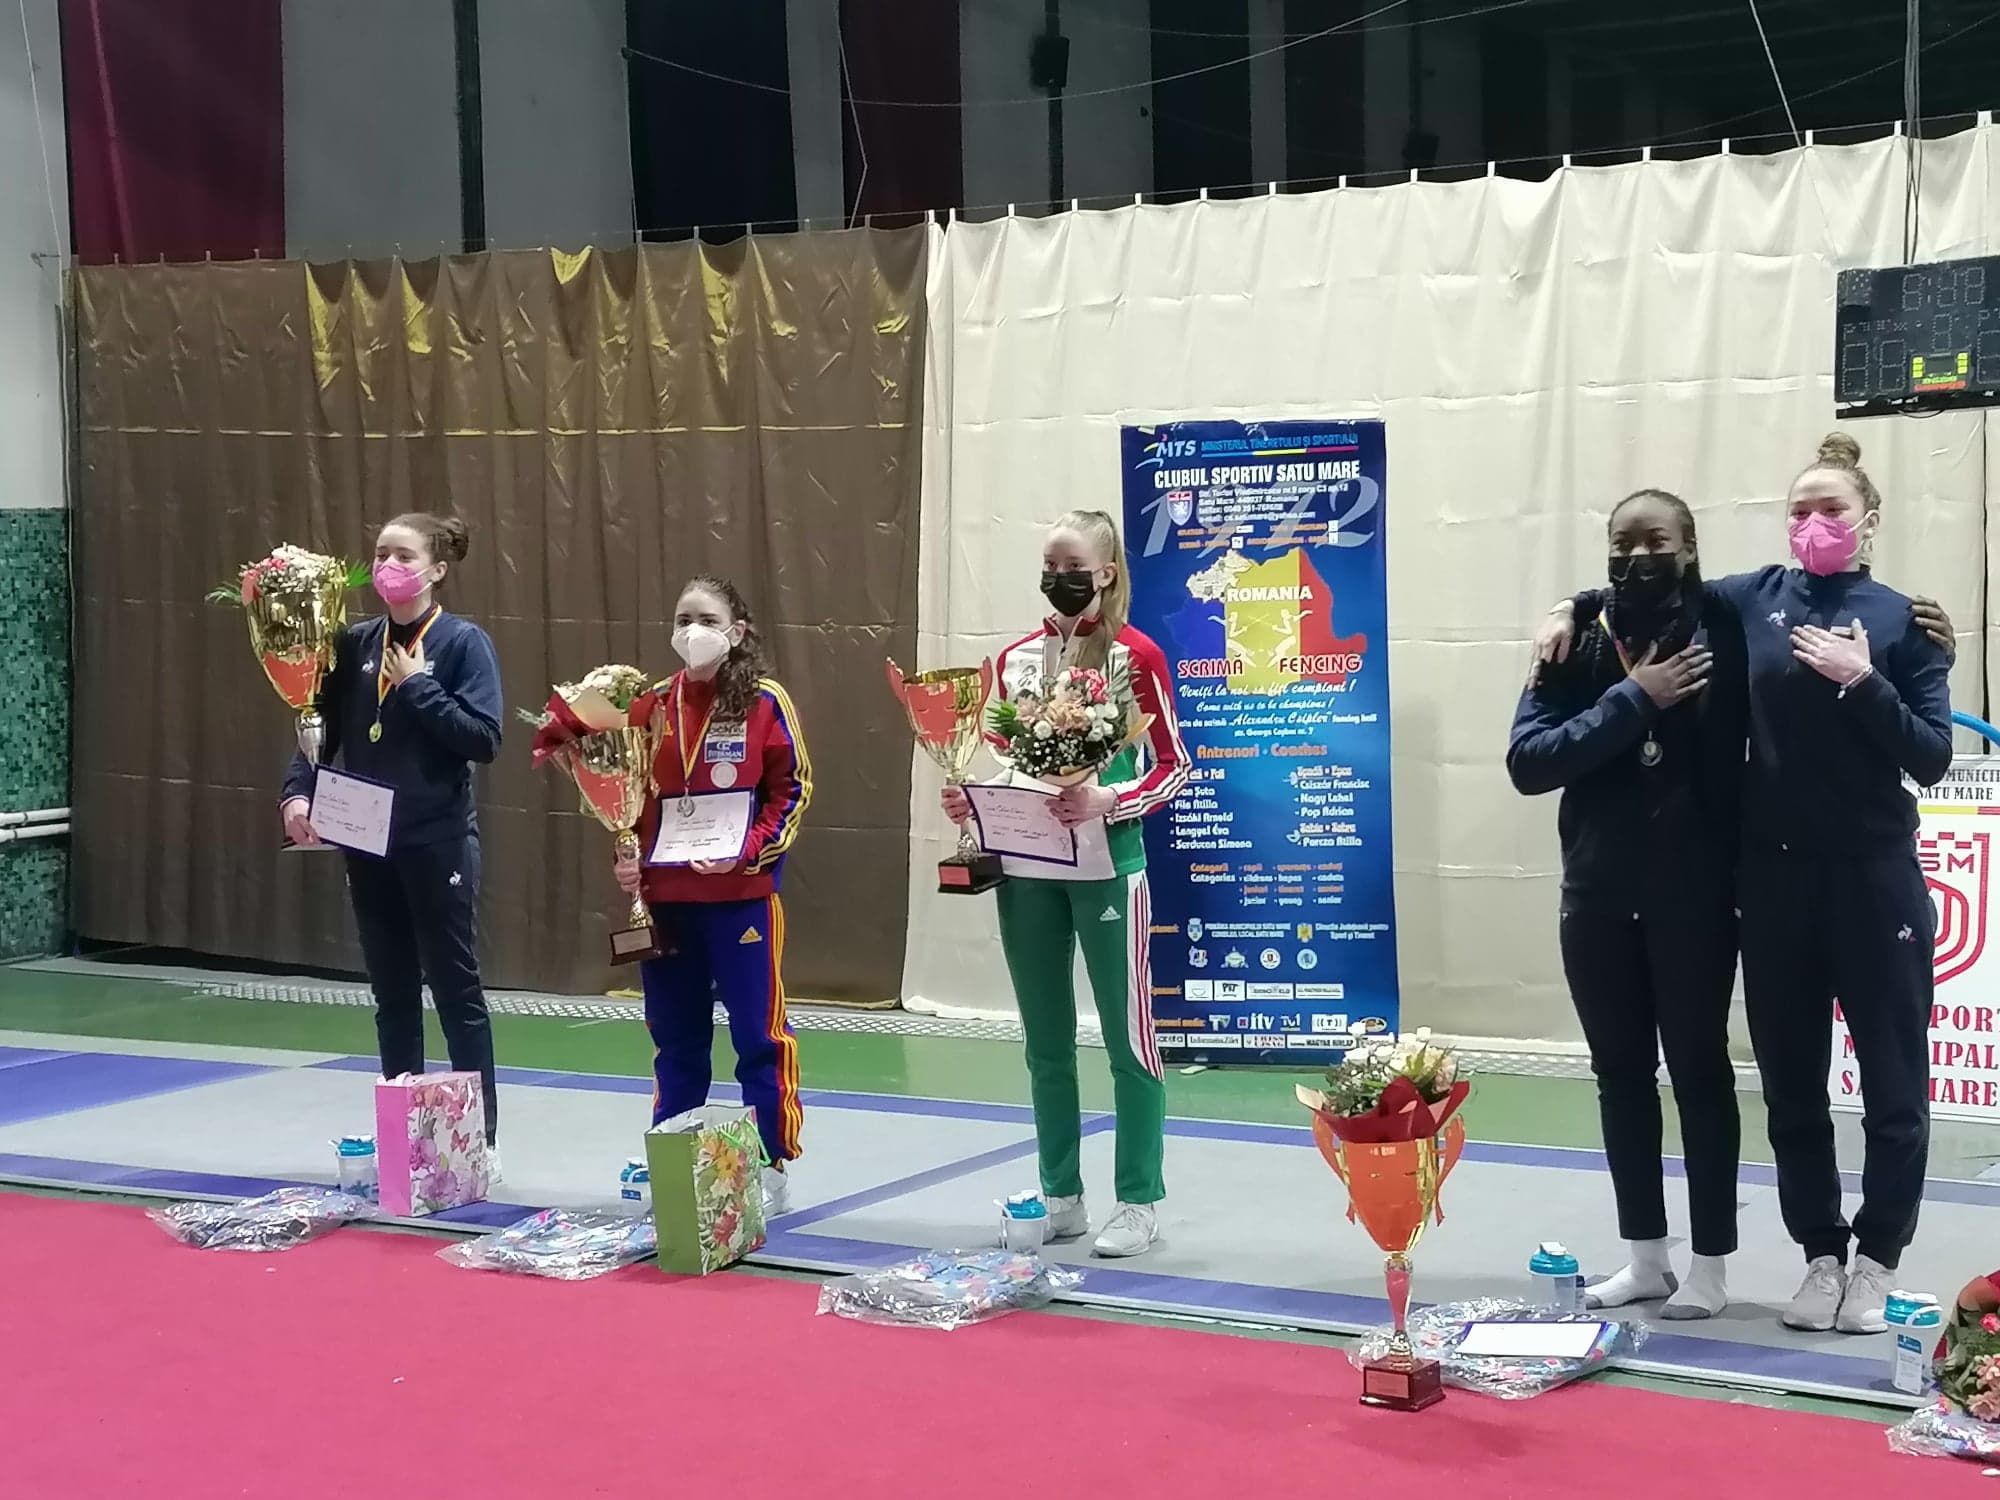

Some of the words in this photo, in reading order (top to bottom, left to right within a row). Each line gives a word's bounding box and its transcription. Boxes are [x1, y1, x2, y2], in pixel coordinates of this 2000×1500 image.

[1155, 439, 1197, 459] MTS
[1201, 439, 1249, 452] MINISTERUL
[1251, 436, 1303, 449] TINERETULUI
[1313, 433, 1358, 446] SPORTULUI
[1154, 467, 1208, 489] CLUBUL
[1211, 464, 1274, 485] SPORTIV
[1276, 462, 1315, 482] SATU
[1318, 460, 1361, 480] MARE
[1227, 585, 1313, 602] ROMANIA
[1177, 654, 1245, 679] SCRIMĂ
[1279, 652, 1364, 675] FENCING
[1215, 684, 1227, 697] la
[1230, 684, 1249, 695] noi
[1291, 681, 1347, 696] campioni
[1196, 701, 1221, 712] Come
[1222, 701, 1243, 711] with
[1278, 699, 1327, 710] champions
[1196, 744, 1260, 760] Antrenori
[1300, 792, 1326, 805] Nagy
[1917, 787, 1950, 799] SATU
[1954, 787, 1993, 800] MARE
[1203, 811, 1233, 822] Arnold
[1301, 806, 1321, 819] Pop
[1322, 805, 1354, 816] Adrian
[1176, 825, 1211, 838] Lengyel
[1218, 838, 1253, 849] Simona
[1917, 852, 1975, 874] SM
[1191, 873, 1235, 884] Categories
